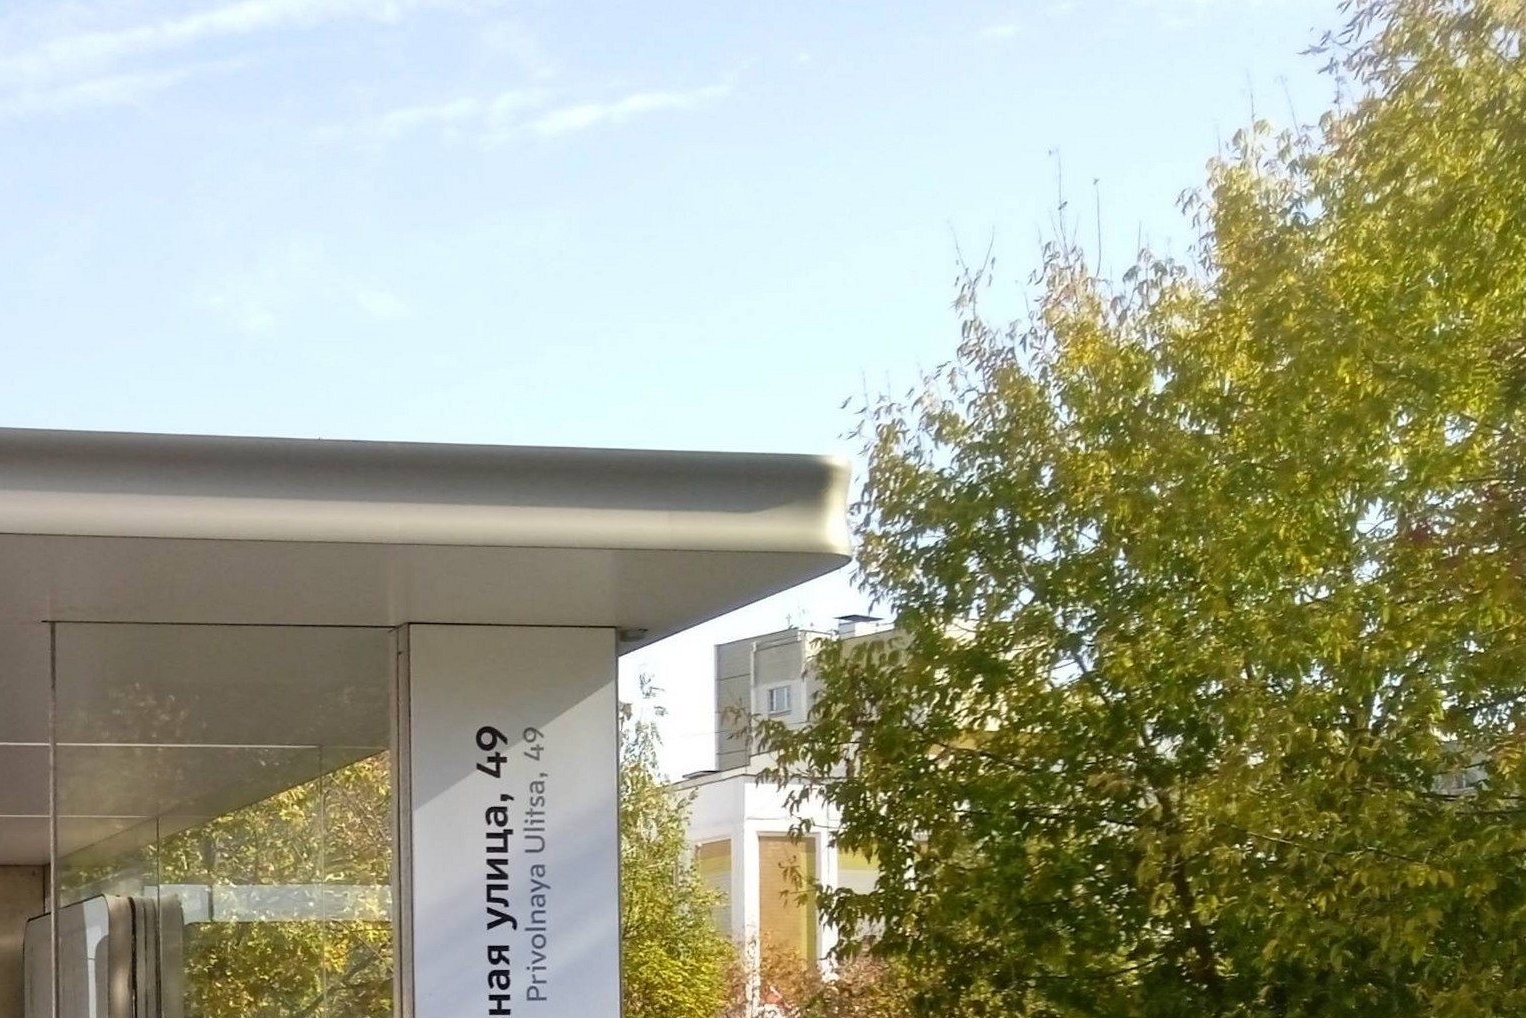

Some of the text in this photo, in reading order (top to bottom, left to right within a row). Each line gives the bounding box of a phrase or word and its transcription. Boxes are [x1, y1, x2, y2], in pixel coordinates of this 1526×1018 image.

[475, 725, 508, 777] 49
[485, 791, 518, 930] улица,
[523, 727, 550, 1002] Privolnaya Ulitsa, 49
